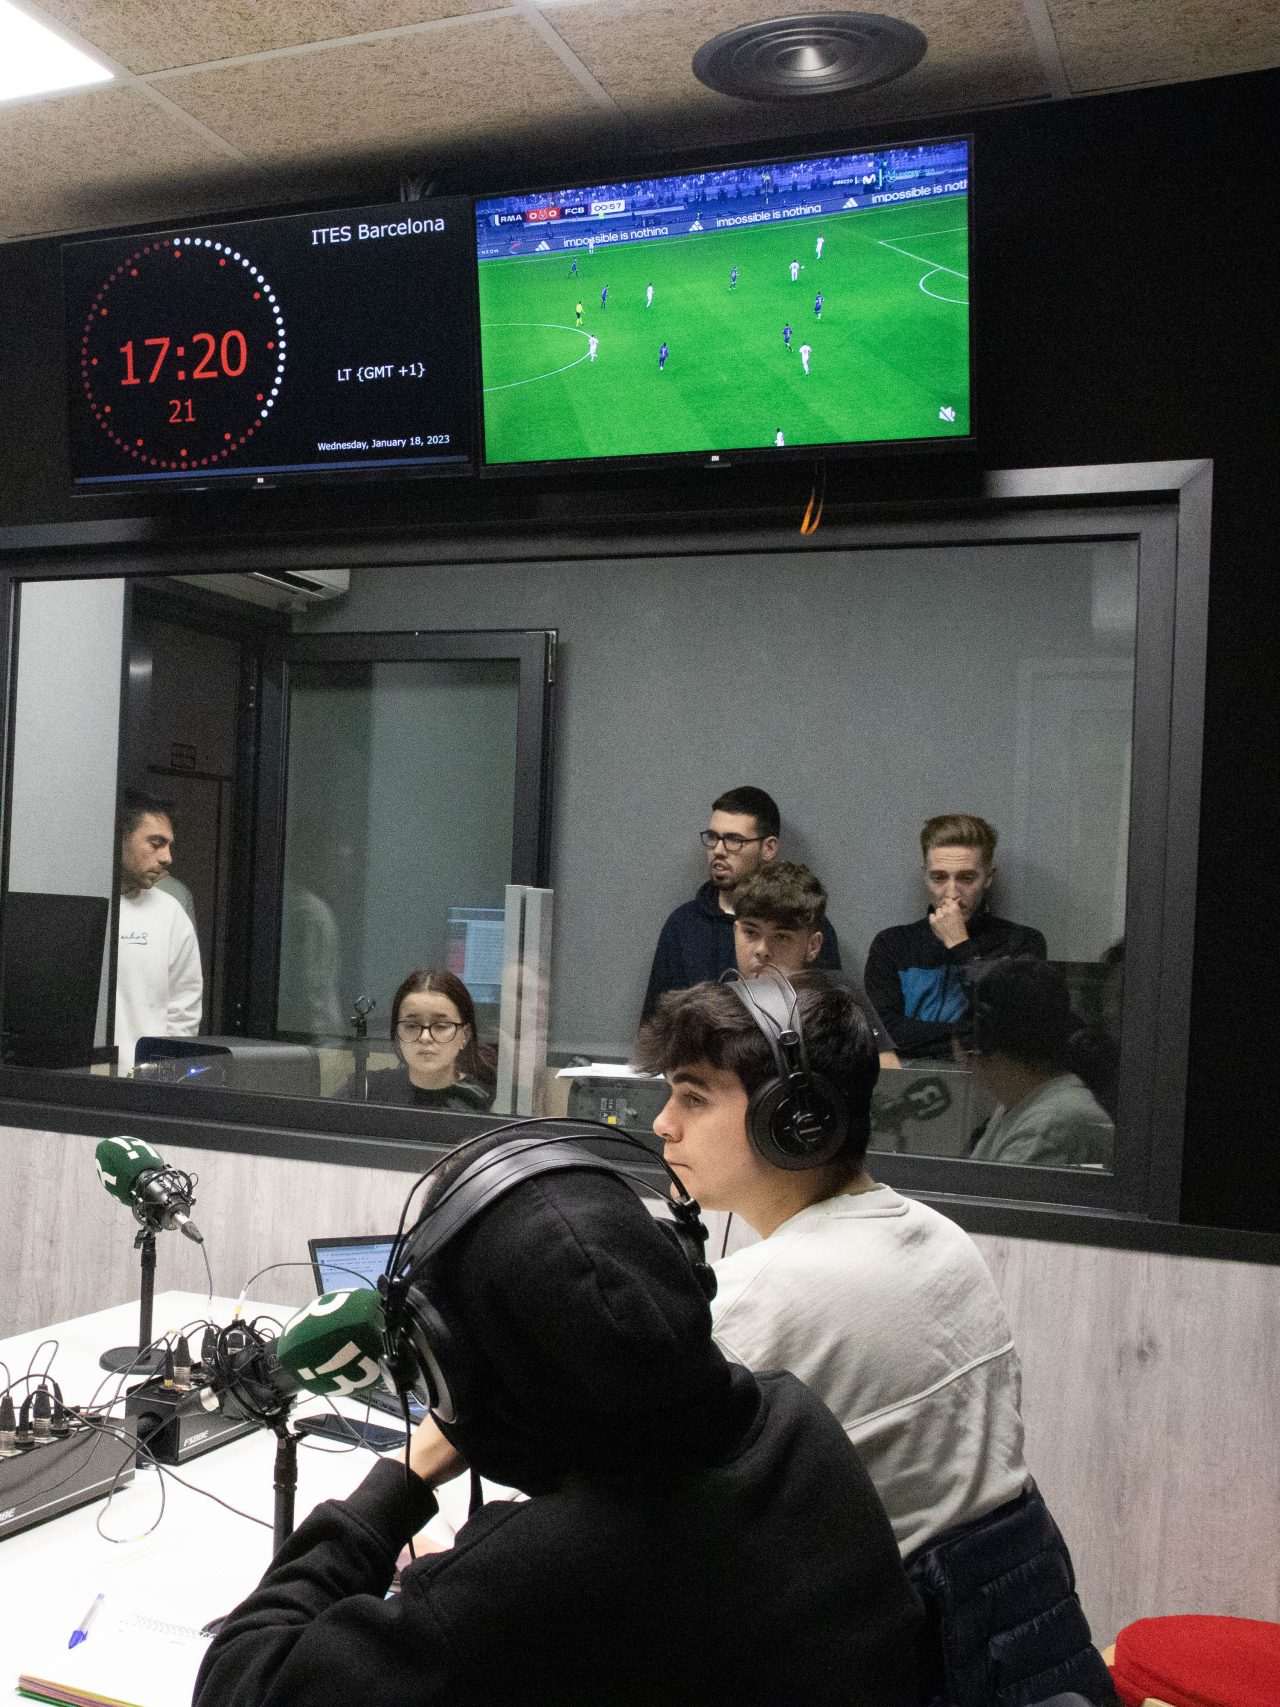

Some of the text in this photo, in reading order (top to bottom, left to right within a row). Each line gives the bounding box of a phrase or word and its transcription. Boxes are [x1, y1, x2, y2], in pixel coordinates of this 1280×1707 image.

[871, 185, 932, 204] impossible
[933, 183, 943, 194] is
[500, 214, 523, 223] RMA
[564, 206, 585, 215] FCB
[716, 211, 771, 228] impossible
[772, 209, 782, 219] is
[311, 217, 446, 245] ITES Barcelona
[620, 230, 629, 240] is
[119, 329, 248, 385] 17:20
[337, 368, 352, 382] LT
[168, 398, 196, 423] 21
[317, 434, 451, 451] Wednesday, January 18, 2023
